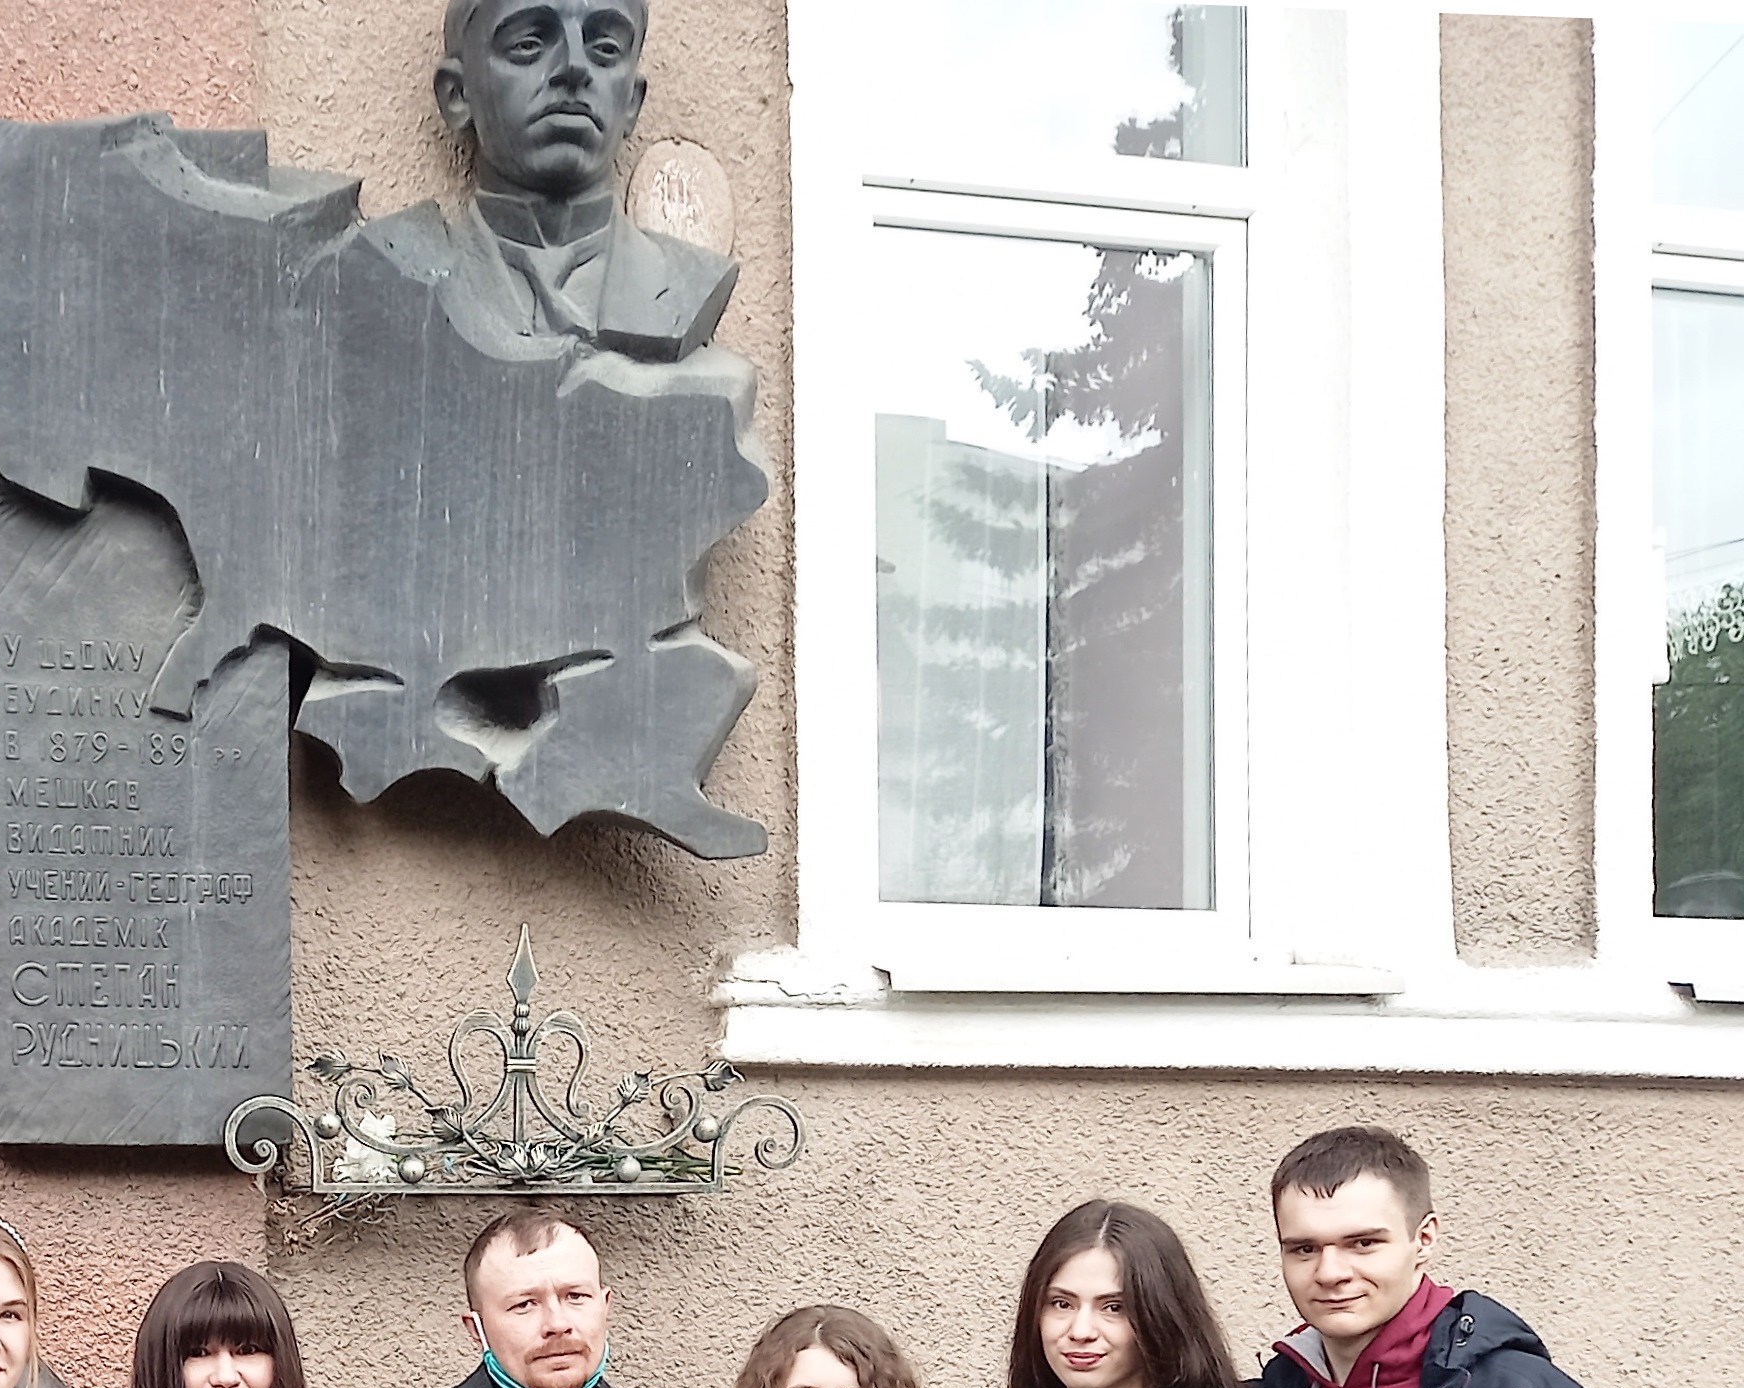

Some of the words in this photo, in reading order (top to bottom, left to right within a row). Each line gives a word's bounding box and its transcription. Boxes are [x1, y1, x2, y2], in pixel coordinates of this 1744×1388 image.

[6, 776, 141, 811] МЕШКАВ
[8, 914, 170, 950] АКАДЕМІК
[11, 960, 181, 1009] СТЕПАН
